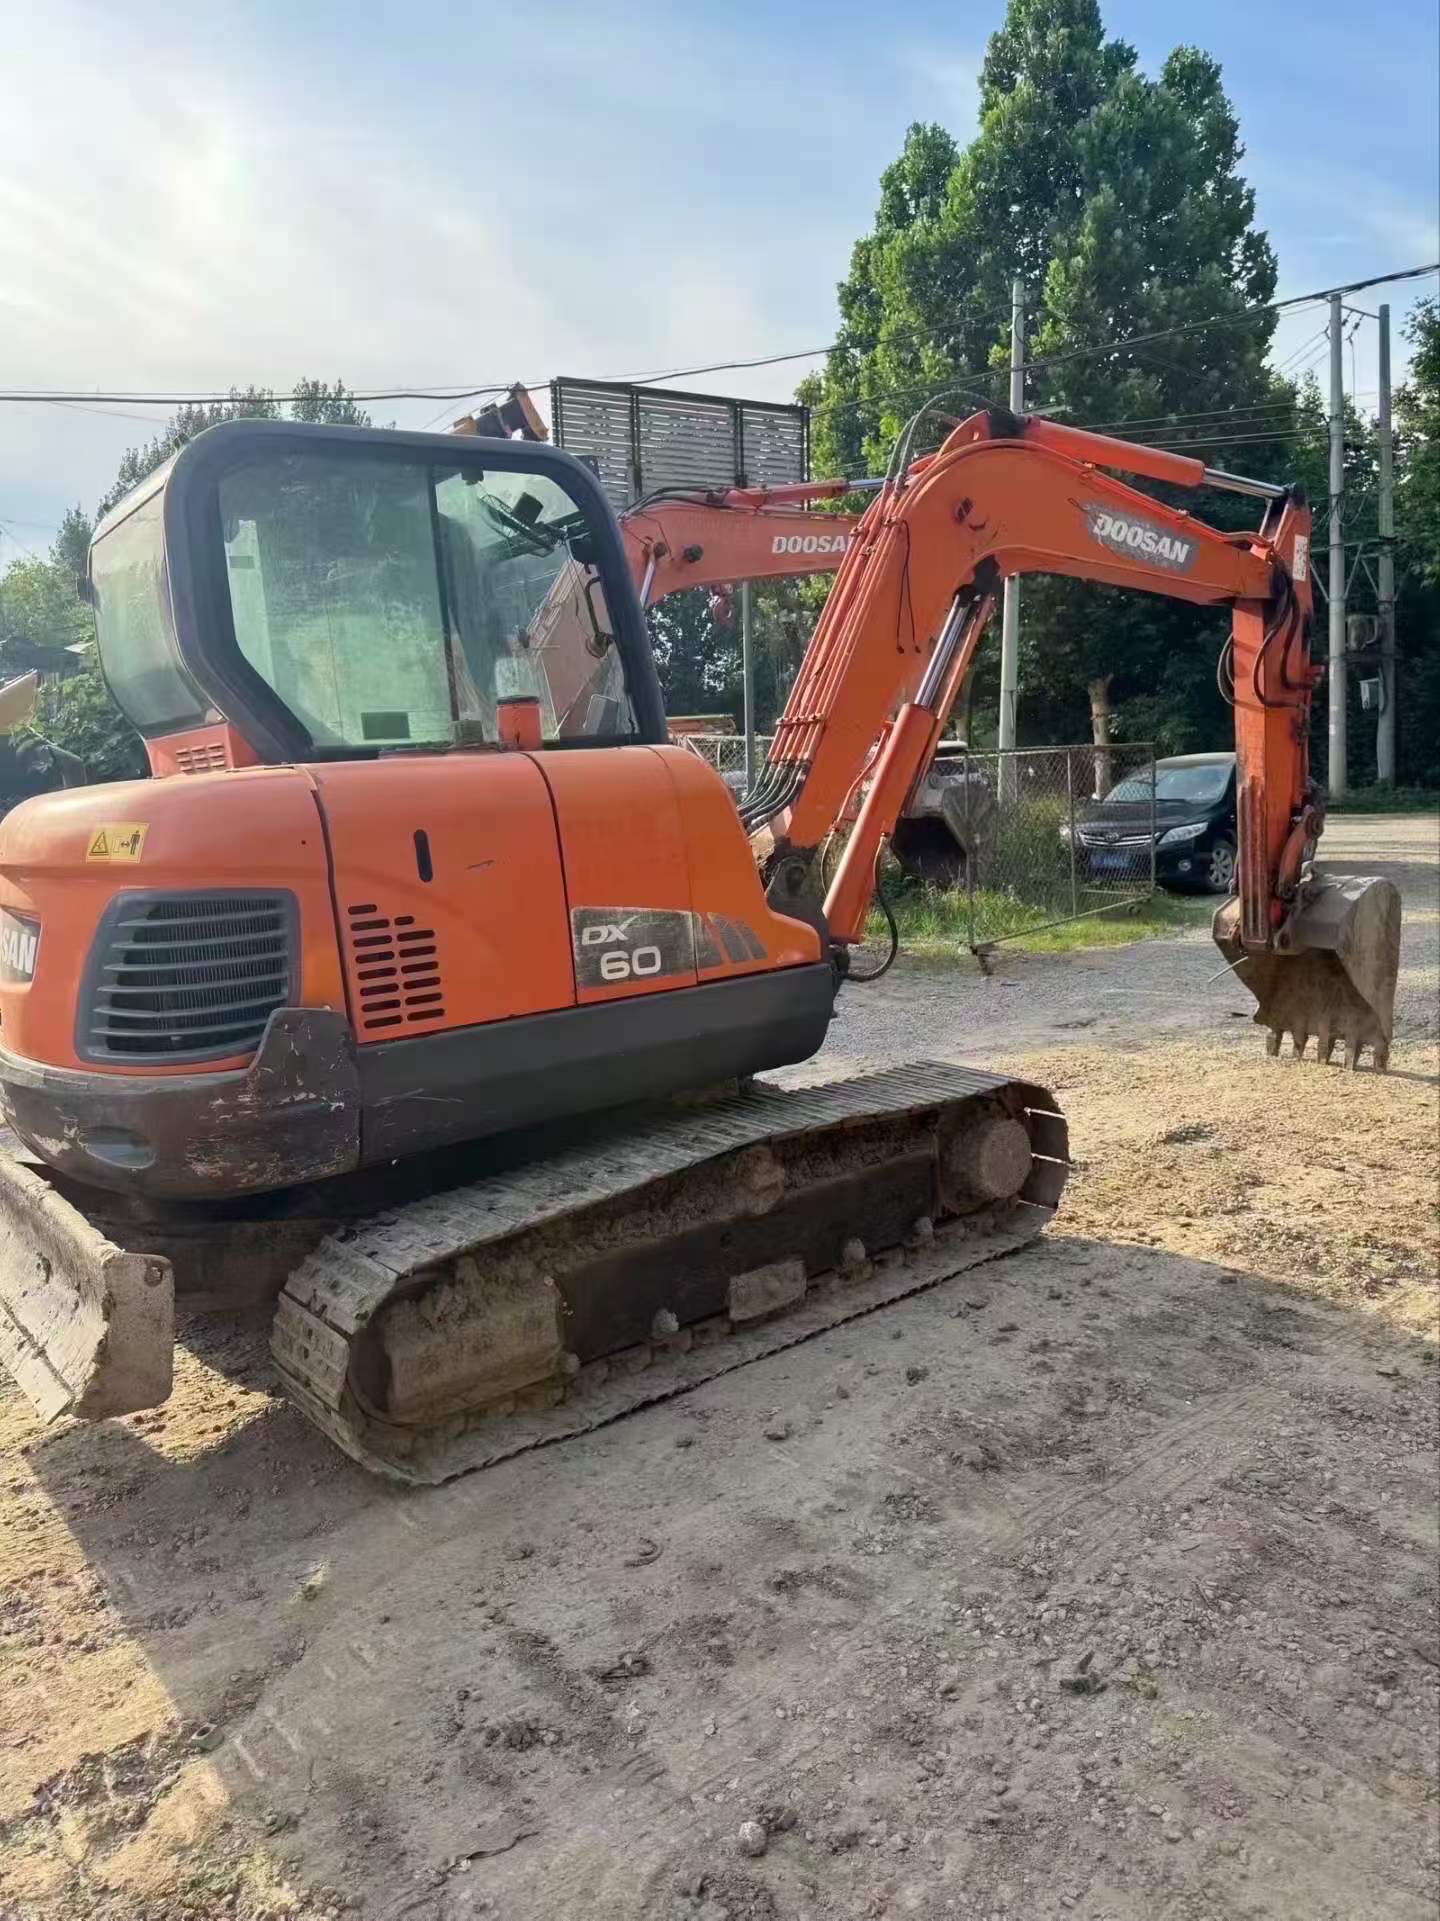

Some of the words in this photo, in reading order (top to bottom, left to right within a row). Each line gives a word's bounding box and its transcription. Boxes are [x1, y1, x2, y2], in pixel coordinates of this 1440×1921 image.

[771, 535, 853, 553] DOOSA
[1093, 513, 1189, 563] DOOSAN
[582, 915, 639, 945] DX
[600, 946, 661, 980] 60
